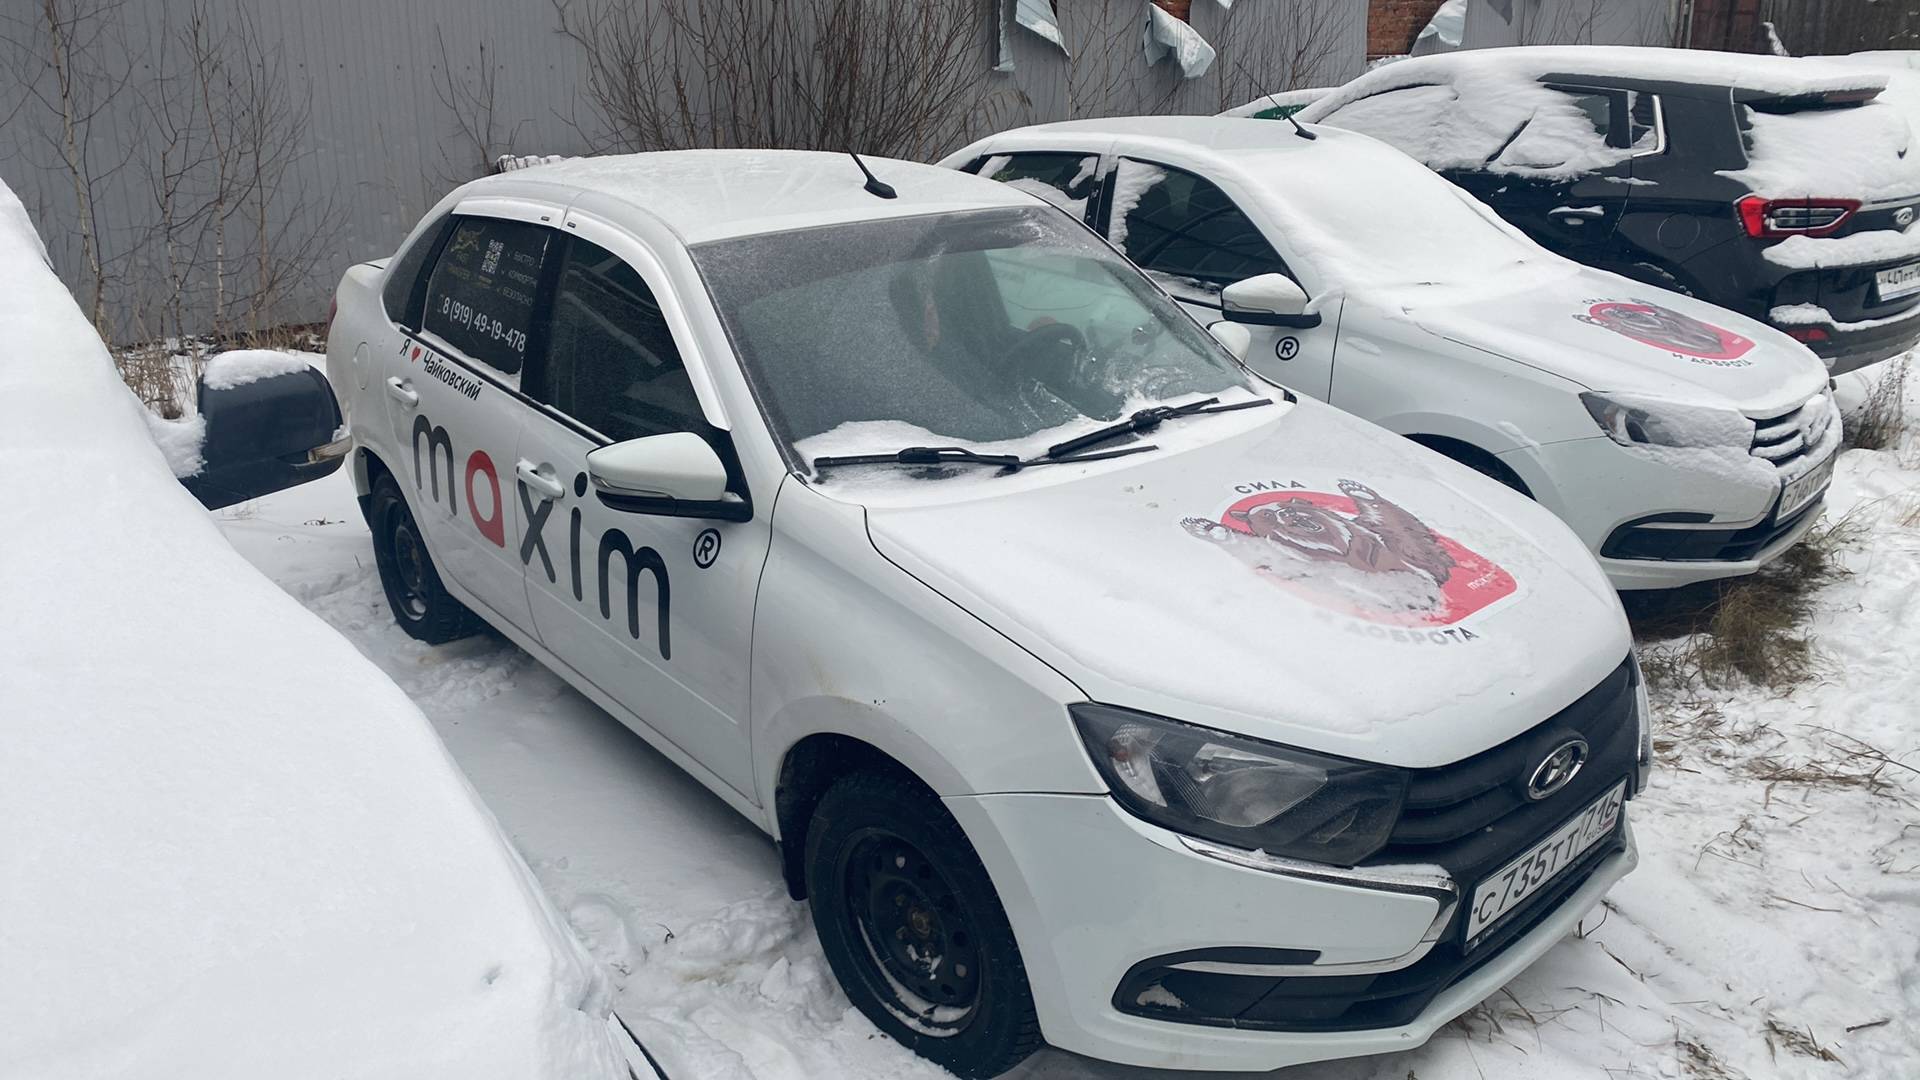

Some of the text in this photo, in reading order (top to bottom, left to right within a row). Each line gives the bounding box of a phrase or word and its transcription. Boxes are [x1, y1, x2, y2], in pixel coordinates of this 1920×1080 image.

[442, 297, 526, 353] 8 (919) 49-19-478
[399, 338, 483, 401] Я Чайковский
[1234, 479, 1307, 495] СИЛА
[412, 414, 671, 661] maxim
